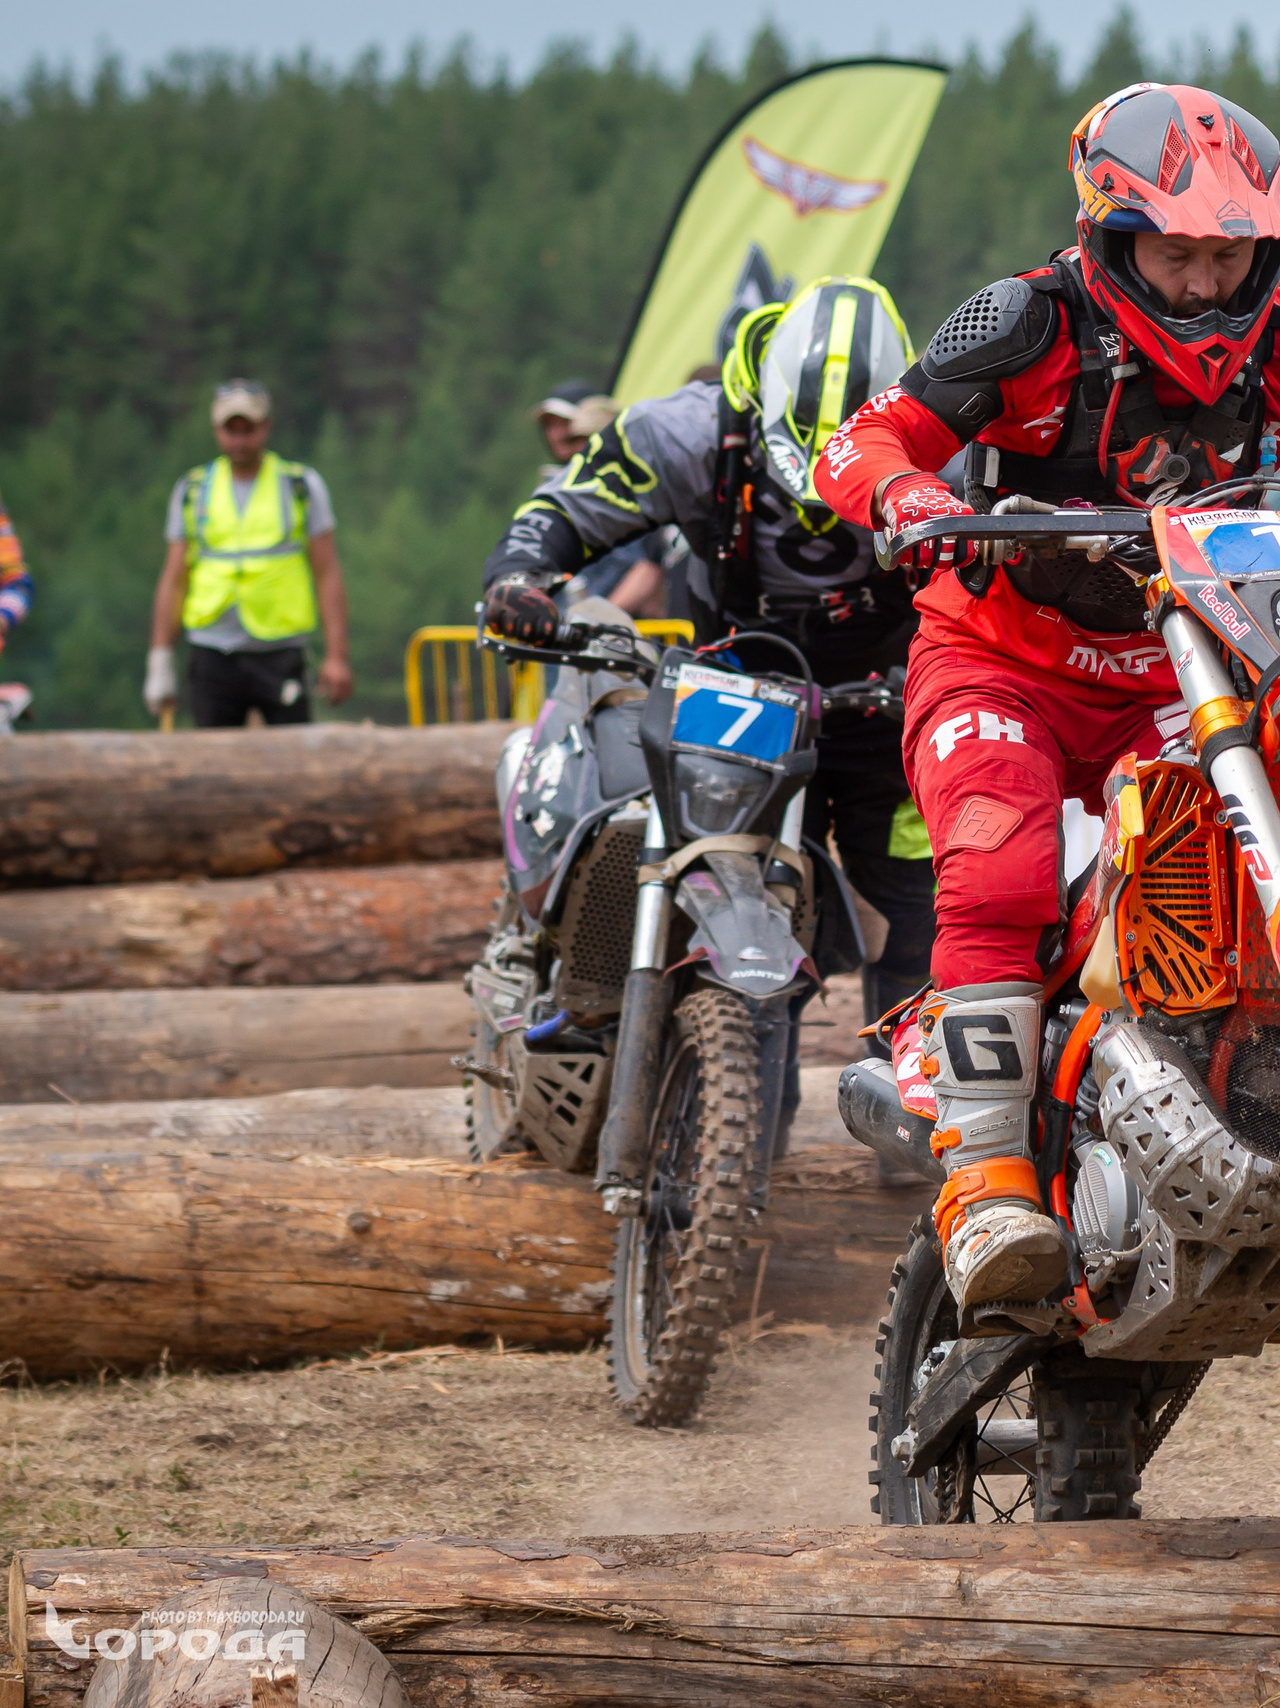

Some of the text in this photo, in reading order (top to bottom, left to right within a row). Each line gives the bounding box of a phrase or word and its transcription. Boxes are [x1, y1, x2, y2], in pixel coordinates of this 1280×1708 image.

[769, 444, 804, 492] Airoh
[505, 511, 553, 559] FOX
[1066, 645, 1169, 680] MXGP
[717, 693, 764, 747] 7
